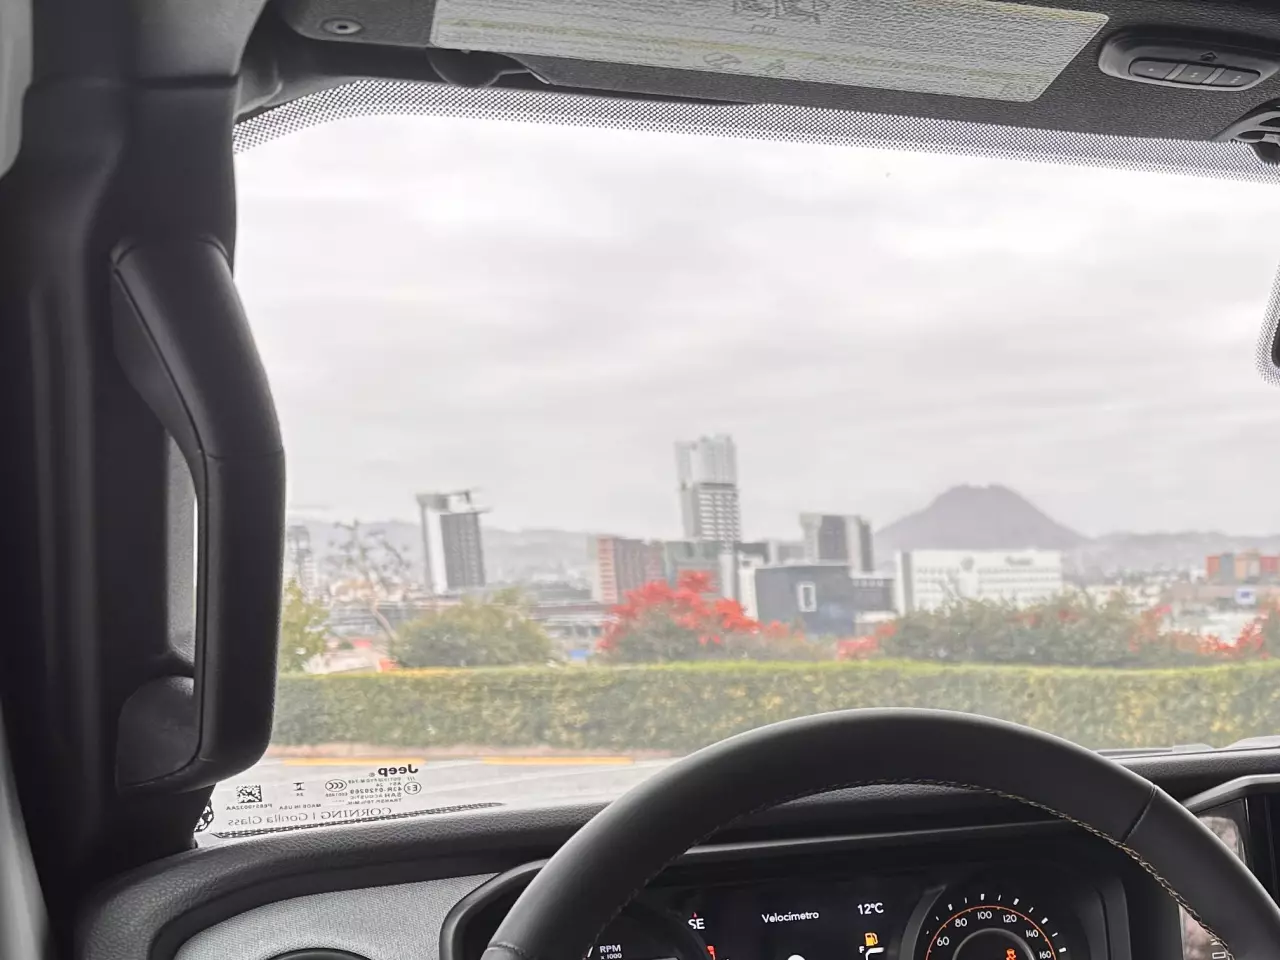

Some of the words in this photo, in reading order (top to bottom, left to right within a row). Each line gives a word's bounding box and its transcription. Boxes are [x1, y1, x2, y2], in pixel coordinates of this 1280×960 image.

[761, 911, 820, 923] Velocímetro
[977, 910, 993, 920] 100
[1003, 913, 1018, 923] 120
[688, 918, 706, 930] SE
[954, 917, 968, 928] 80
[1025, 929, 1039, 938] 140
[936, 936, 950, 947] 60
[599, 944, 621, 953] RPM
[858, 946, 865, 954] F
[1039, 950, 1051, 960] 160
